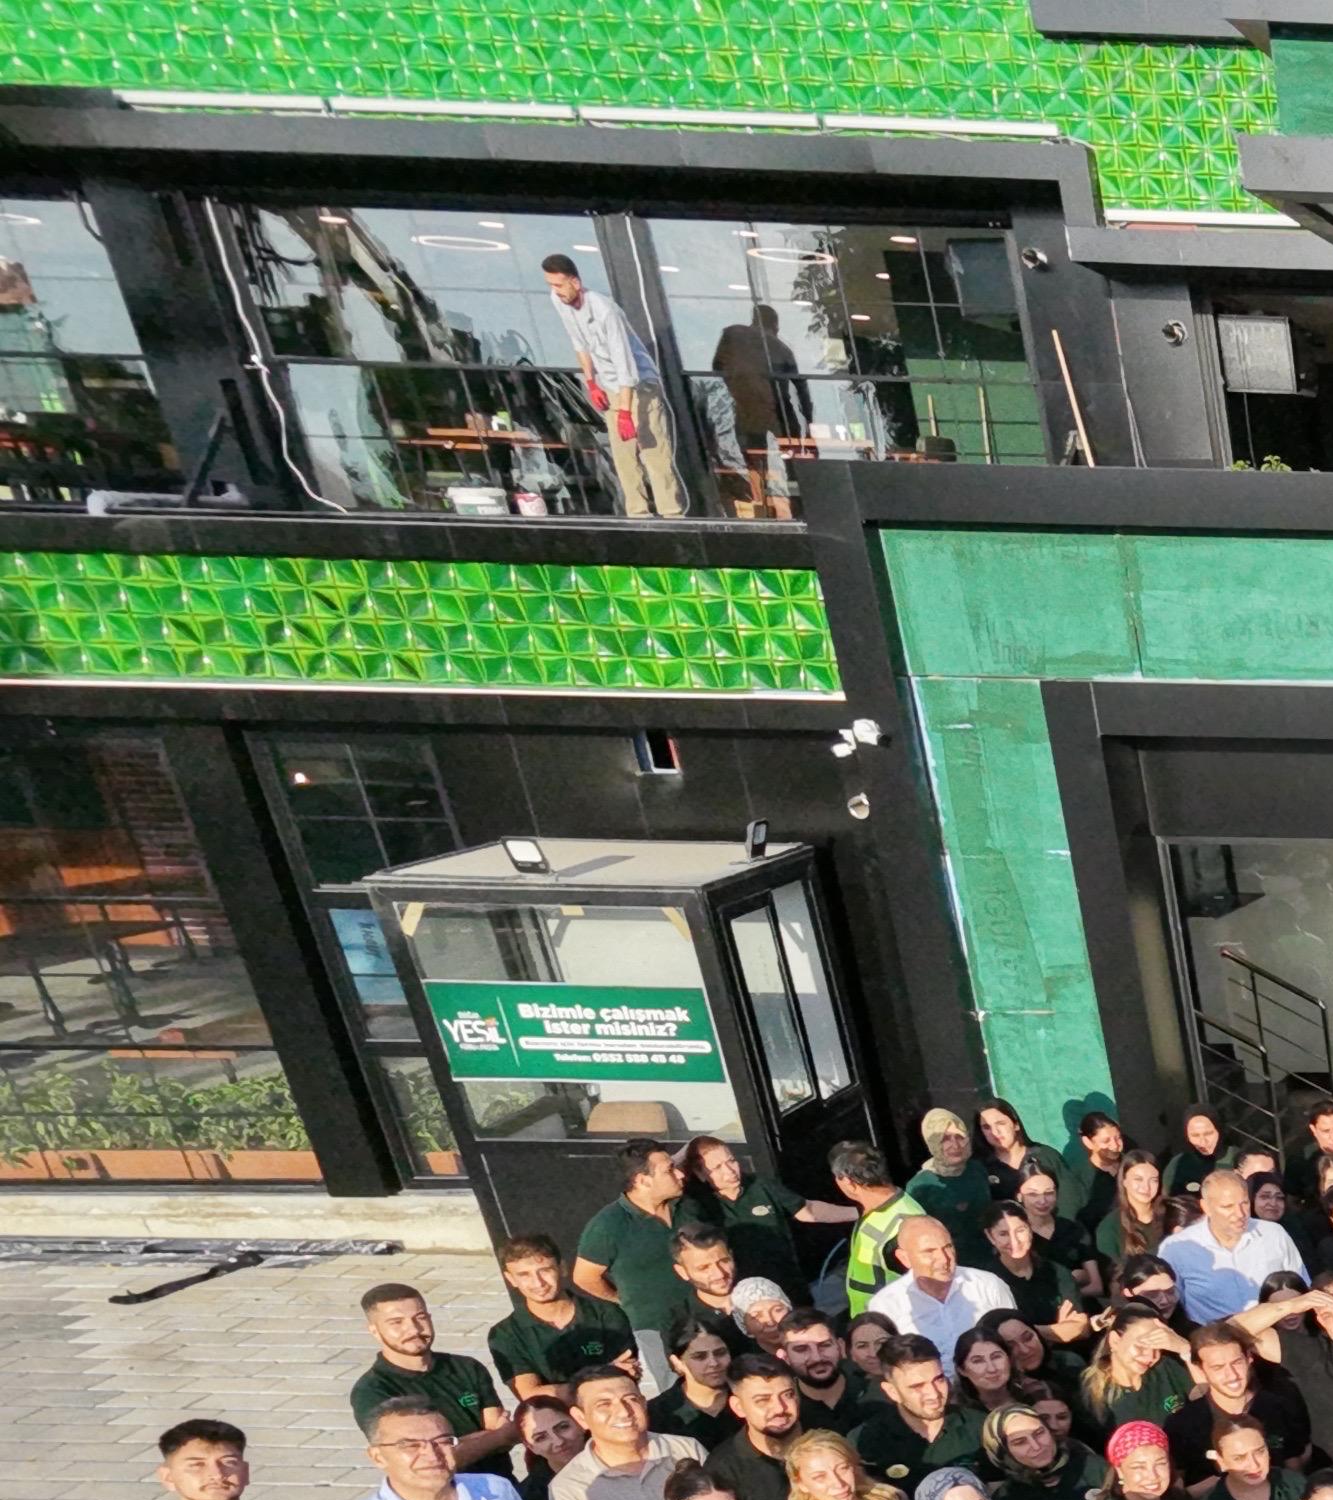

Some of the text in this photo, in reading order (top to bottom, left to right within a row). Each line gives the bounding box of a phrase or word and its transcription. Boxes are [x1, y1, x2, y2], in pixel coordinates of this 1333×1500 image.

[517, 1003, 691, 1023] Bizimle çalışmak
[595, 1021, 679, 1037] misiniz?
